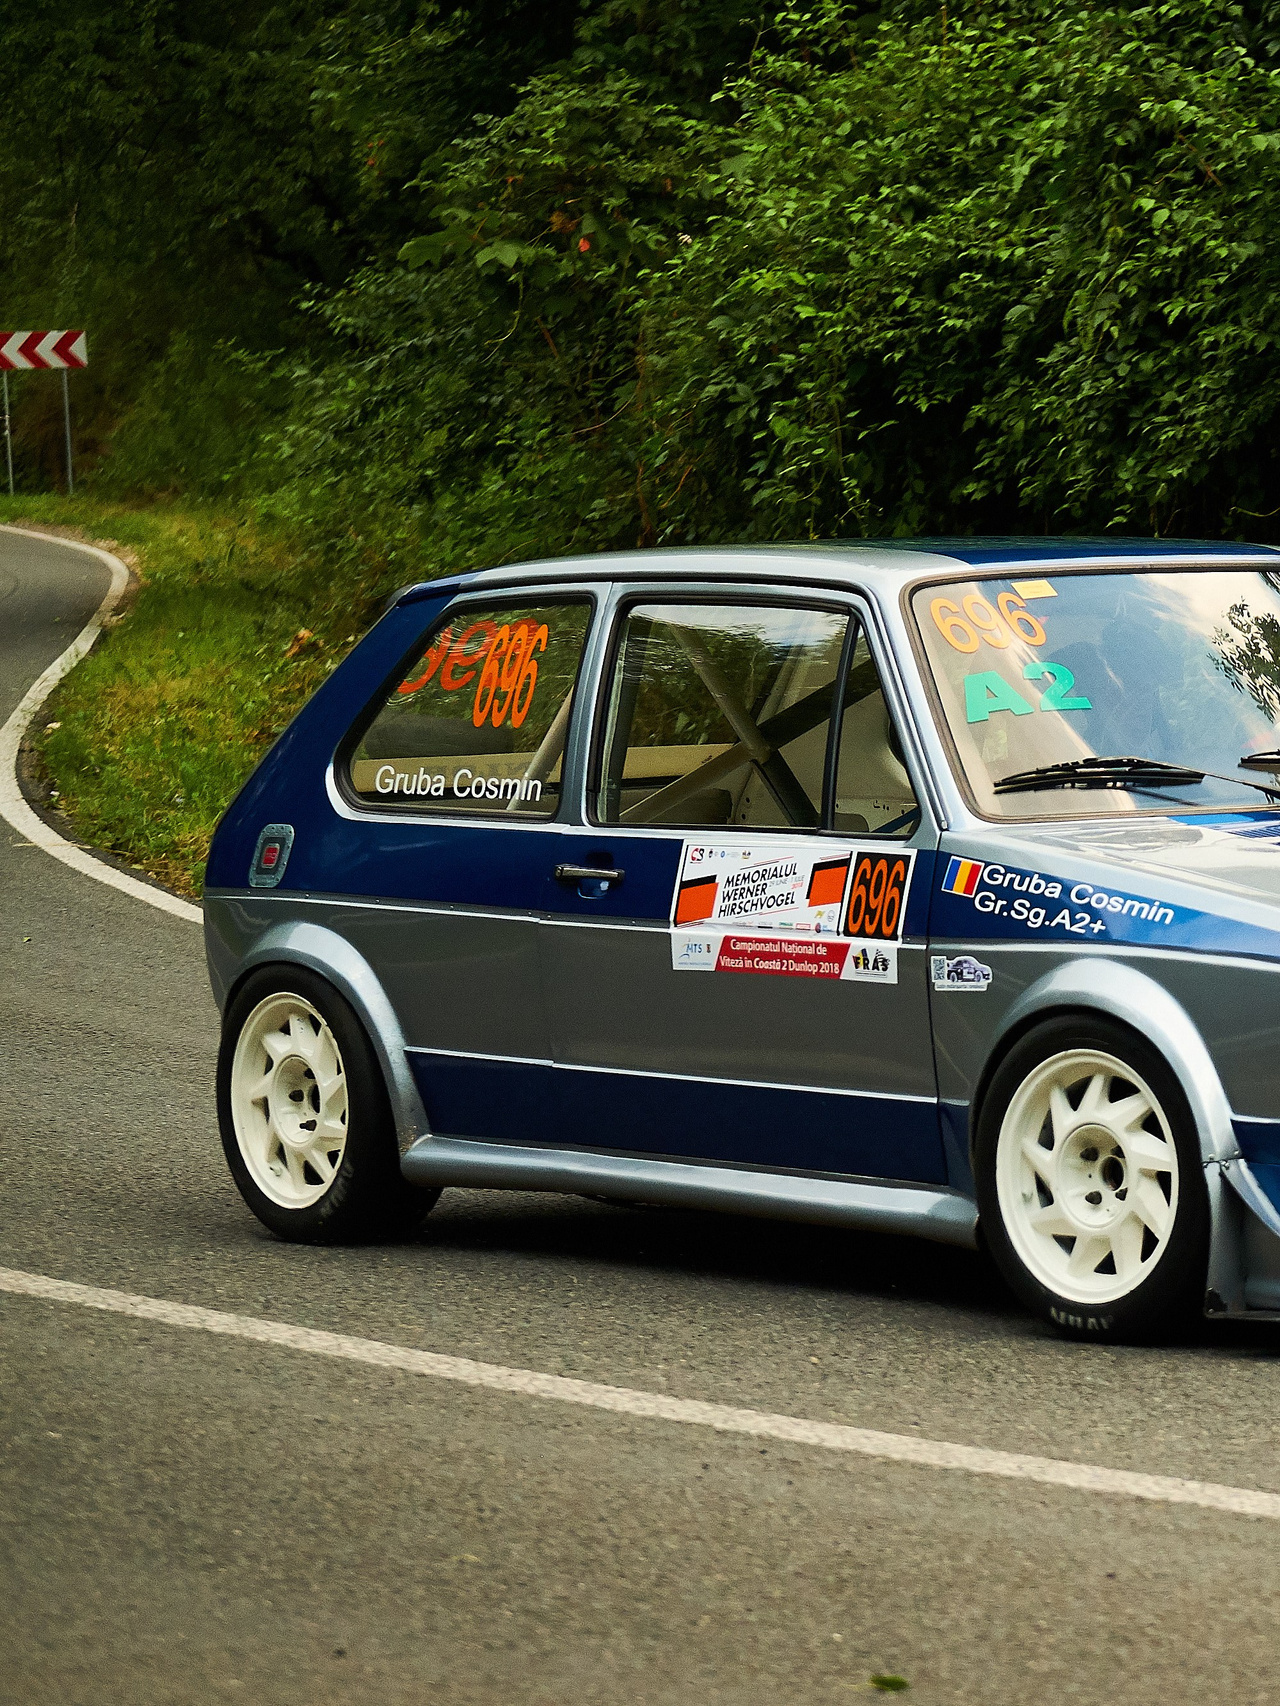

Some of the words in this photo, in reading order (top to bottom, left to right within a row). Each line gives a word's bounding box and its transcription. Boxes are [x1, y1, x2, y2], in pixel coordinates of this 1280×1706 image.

[930, 591, 1047, 654] 696
[472, 623, 548, 729] 696
[963, 661, 1093, 724] A2
[375, 765, 446, 796] Gruba
[453, 769, 543, 802] Cosmin
[722, 882, 768, 904] WERNER
[724, 862, 798, 889] MEMORIALUL
[718, 891, 795, 919] HIRSCHVOGEL
[847, 857, 906, 938] 696
[974, 891, 1107, 935] Gr.Sg.A2+
[982, 864, 1063, 899] Gruba
[1070, 884, 1175, 926] Cosmin
[719, 955, 744, 968] Viteză
[781, 960, 787, 971] 2
[788, 960, 819, 975] Dunlop
[819, 962, 840, 974] 2018
[730, 938, 780, 954] Campionatul
[781, 941, 816, 956] Național
[816, 944, 828, 956] de
[852, 951, 890, 972] FRAS
